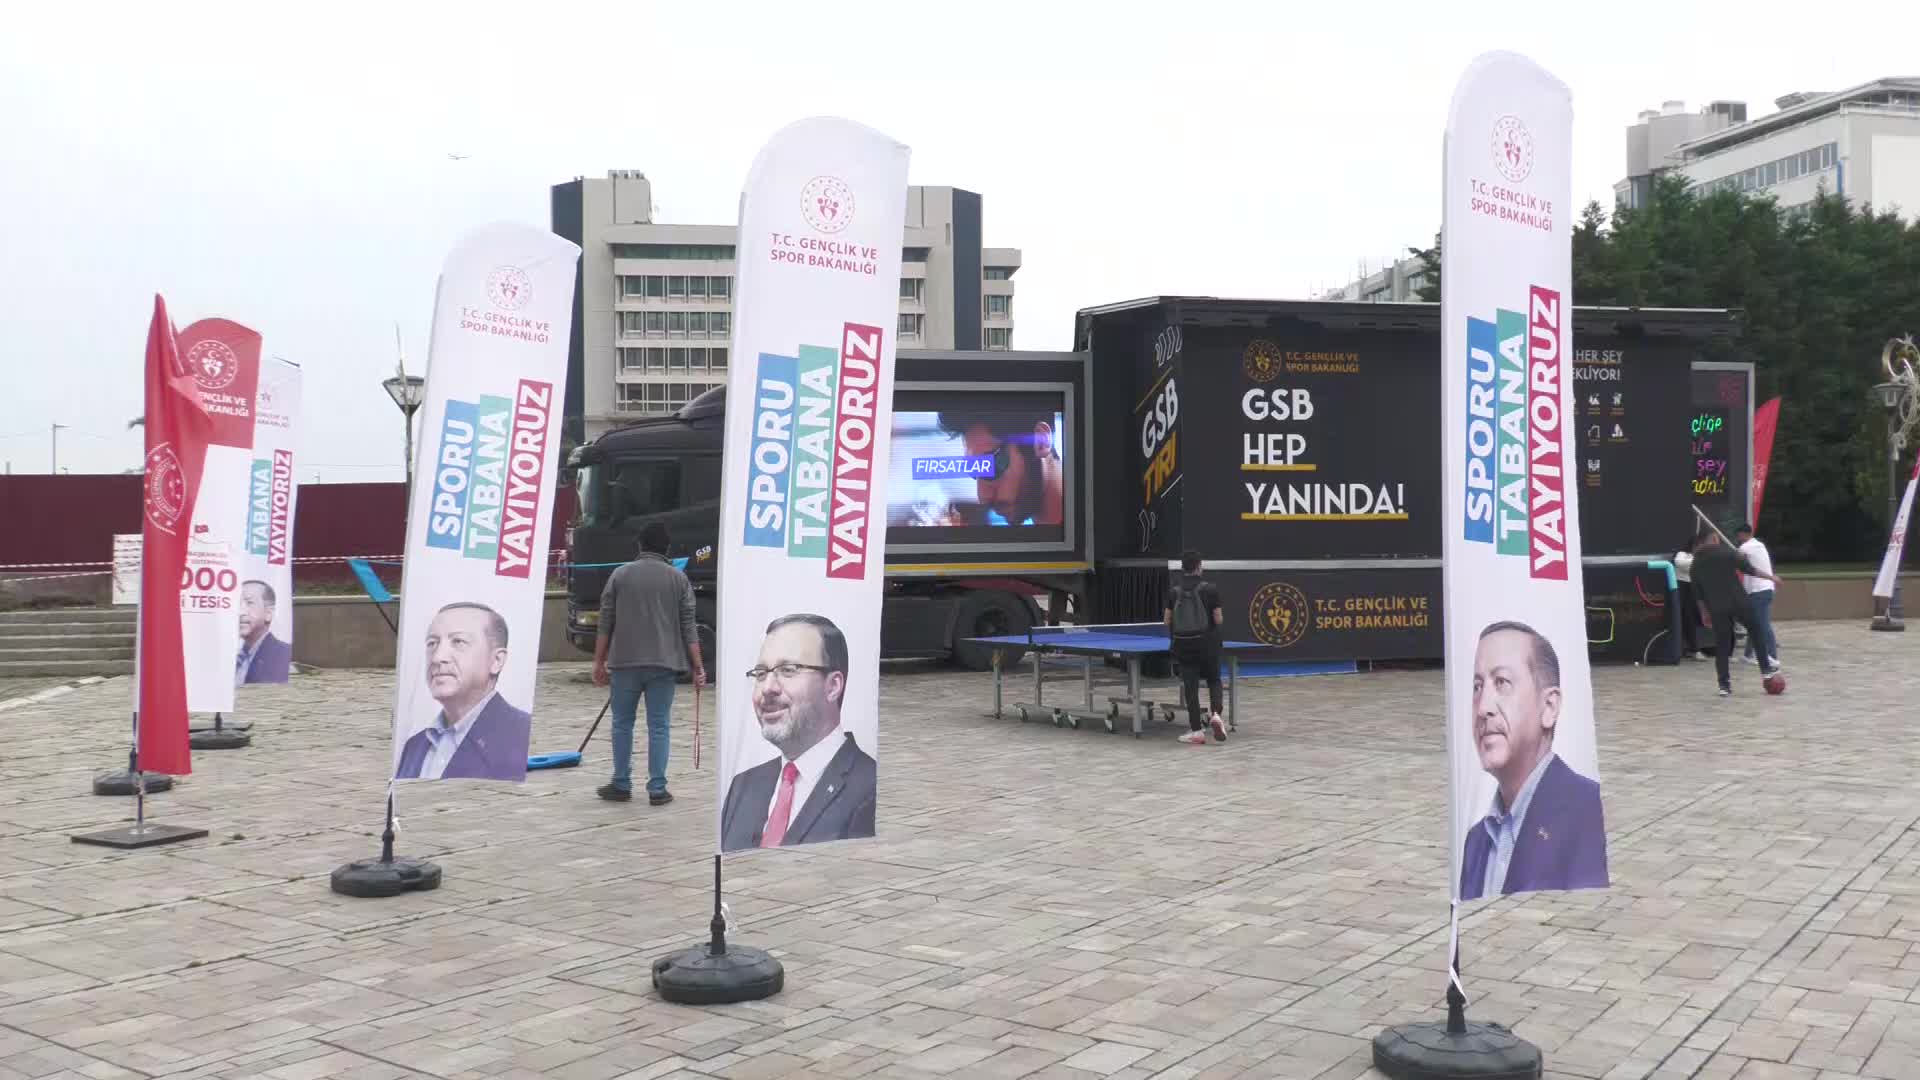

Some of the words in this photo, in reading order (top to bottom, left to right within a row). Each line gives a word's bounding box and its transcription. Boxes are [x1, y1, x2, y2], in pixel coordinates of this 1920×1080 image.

[1471, 178, 1489, 196] T.C.
[1492, 186, 1537, 210] GENÇLİK
[1540, 200, 1552, 214] VE
[1472, 198, 1497, 216] SPOR
[1500, 206, 1552, 232] BAKANLIĞI
[771, 249, 805, 264] SPOR
[809, 255, 876, 275] BAKANLIĞI
[772, 233, 795, 247] T.C.
[800, 238, 857, 257] GENÇLİK
[862, 247, 877, 260] VE
[460, 320, 488, 332] SPOR
[491, 325, 549, 344] BAKANLIĞI
[463, 307, 481, 320] T.C.
[535, 321, 549, 332] VE
[1571, 365, 1620, 380] EKLİYOR!
[1576, 350, 1598, 361] HER
[1142, 378, 1178, 458] GSB
[1242, 388, 1314, 420] GSB
[1243, 433, 1306, 465] HEP
[1467, 346, 1496, 524] SPORU
[1500, 333, 1526, 540] TABANA
[1530, 293, 1562, 574] YAYIYORUZ
[749, 378, 794, 532] SPORU
[794, 365, 834, 545] TABANA
[831, 329, 878, 575] YAYIYORUZ
[916, 460, 992, 473] FIRSATLAR
[431, 420, 474, 537] SPORU
[469, 411, 509, 549] TABANA
[498, 385, 549, 573] YAYIYORUZ
[253, 468, 271, 549] TABANA
[269, 451, 291, 562] YAYIYORUZ
[1245, 482, 1404, 515] YANINDA!
[1316, 599, 1340, 611] T.C.
[1344, 595, 1406, 613] GENÇLİK
[1410, 597, 1428, 609] VE
[1316, 615, 1351, 629] SPOR
[1355, 612, 1428, 627] BAKANLIĞI
